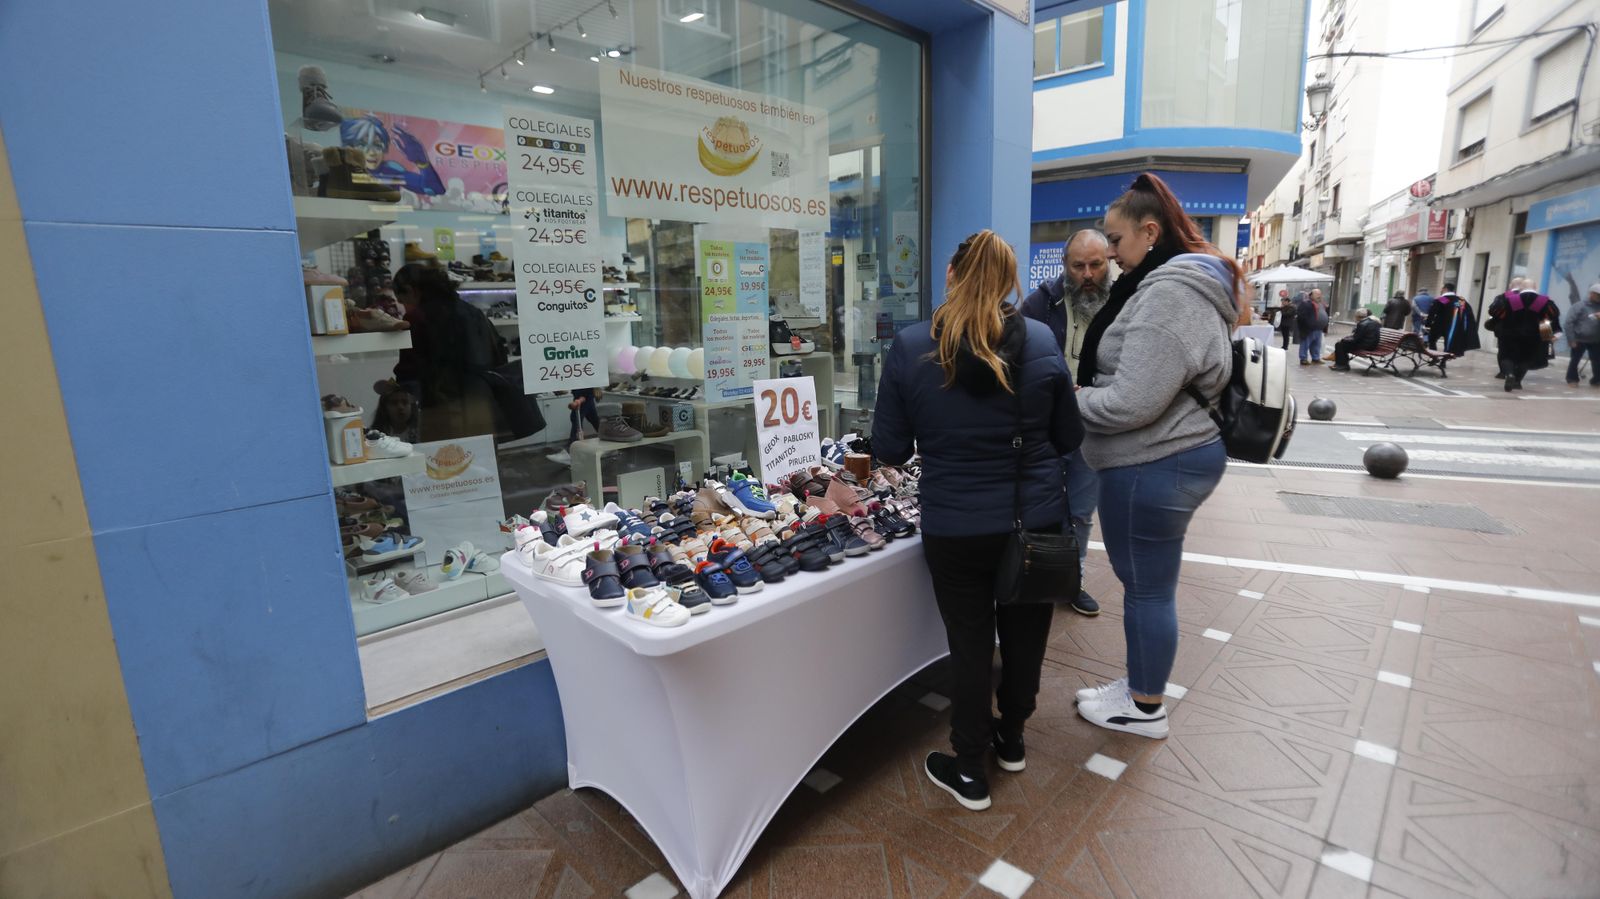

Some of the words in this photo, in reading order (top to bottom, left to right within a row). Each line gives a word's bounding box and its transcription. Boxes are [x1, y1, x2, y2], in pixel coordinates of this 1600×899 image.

[619, 69, 682, 96] Nuestros
[686, 84, 758, 114] respetuosos
[760, 98, 802, 122] también
[802, 114, 816, 126] en
[508, 117, 592, 138] COLEGIALES
[702, 124, 761, 154] respetuosos
[434, 142, 507, 161] GEOX
[520, 154, 585, 175] 24,95€
[516, 191, 593, 206] COLEGIALES
[612, 176, 828, 217] www.respetuosos.es
[543, 208, 586, 220] titanitos
[528, 228, 588, 245] 24,95€
[522, 263, 596, 274] COLEGIALES
[1030, 265, 1064, 280] SEGUR
[528, 280, 586, 296] 24,95€
[704, 286, 732, 296] 24,95€
[740, 282, 766, 291] 19,95€
[538, 300, 588, 312] Conguitos
[528, 330, 600, 344] COLEGIALES
[544, 345, 588, 360] Gorila
[742, 344, 766, 352] GEOX
[744, 358, 766, 368] 29,95€
[540, 363, 595, 381] 24,95€
[707, 368, 736, 379] 19,95€
[760, 387, 812, 428] 20€
[764, 434, 780, 454] GEOX
[784, 432, 814, 444] PABLOSKY
[766, 445, 796, 472] TITANITOS
[788, 454, 816, 467] PIRUFLEX
[408, 475, 494, 494] www.respetuosos.es
